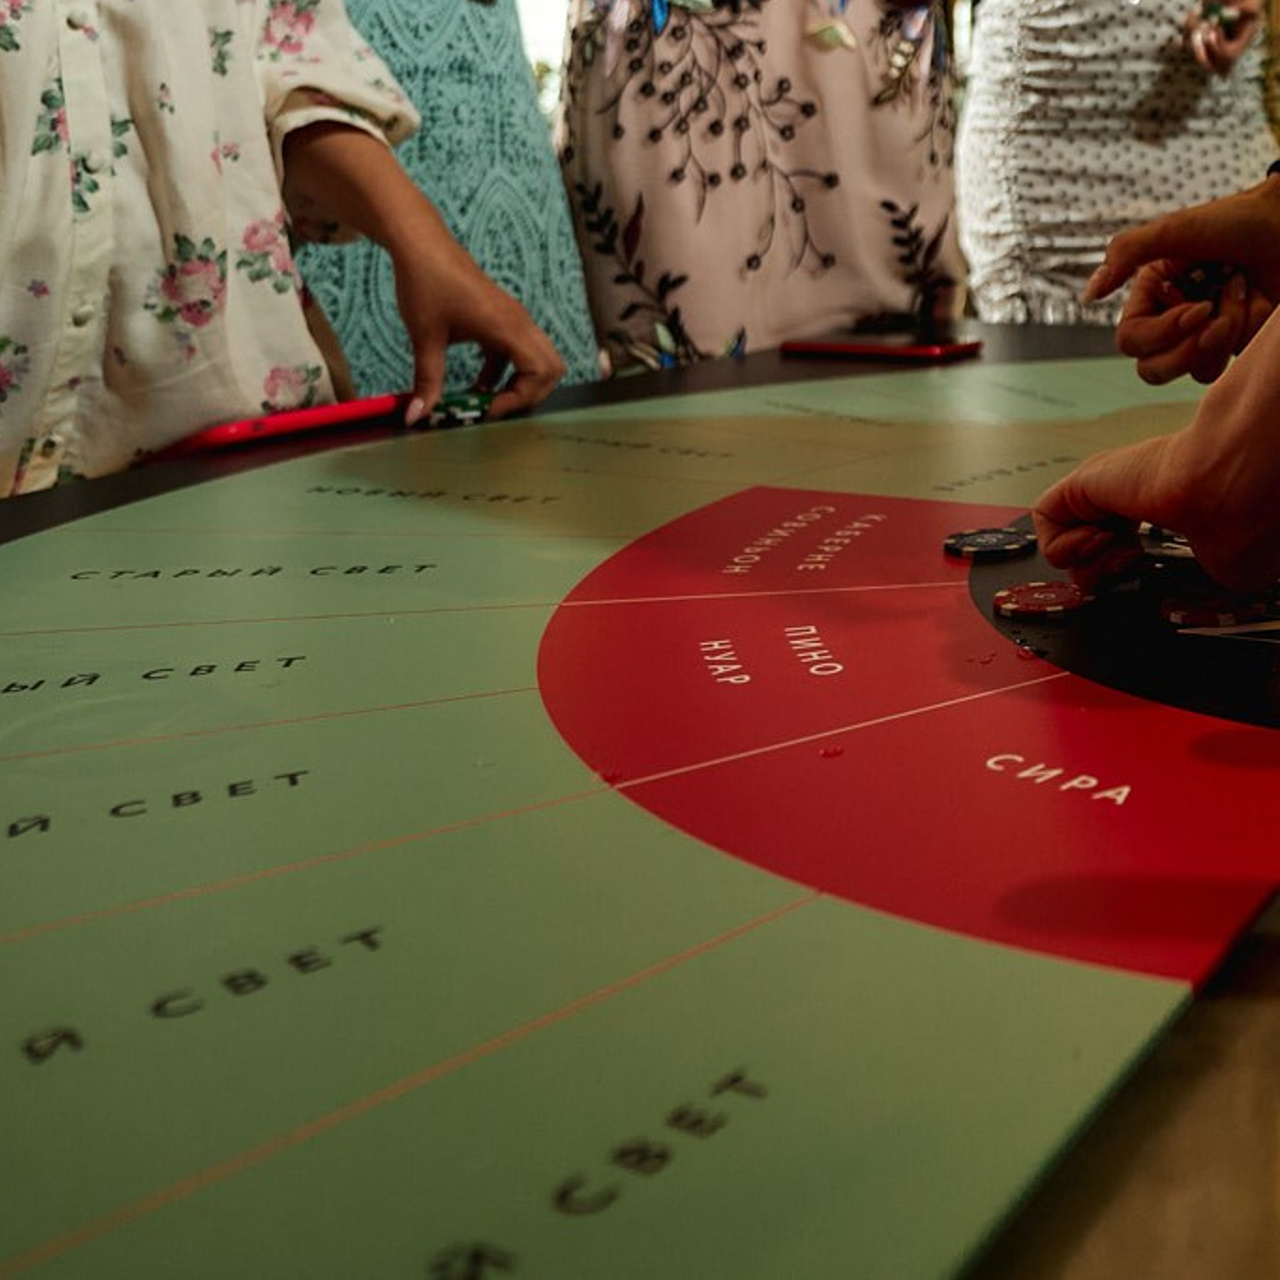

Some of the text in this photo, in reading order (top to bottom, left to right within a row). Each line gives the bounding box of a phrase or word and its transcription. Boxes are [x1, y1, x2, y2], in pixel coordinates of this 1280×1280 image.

[722, 505, 837, 574] СОВИНЬОН
[797, 514, 888, 570] КАБЕРНЕ
[70, 563, 438, 581] СТАРЫЙ СВЕТ
[142, 655, 306, 681] СВЕТ
[699, 639, 751, 684] НУАР
[784, 625, 844, 675] ПИНО
[109, 770, 310, 818] СВЕТ
[986, 754, 1131, 805] СИРА
[150, 926, 382, 1019] СВЕТ
[552, 1065, 769, 1216] СВЕТ
